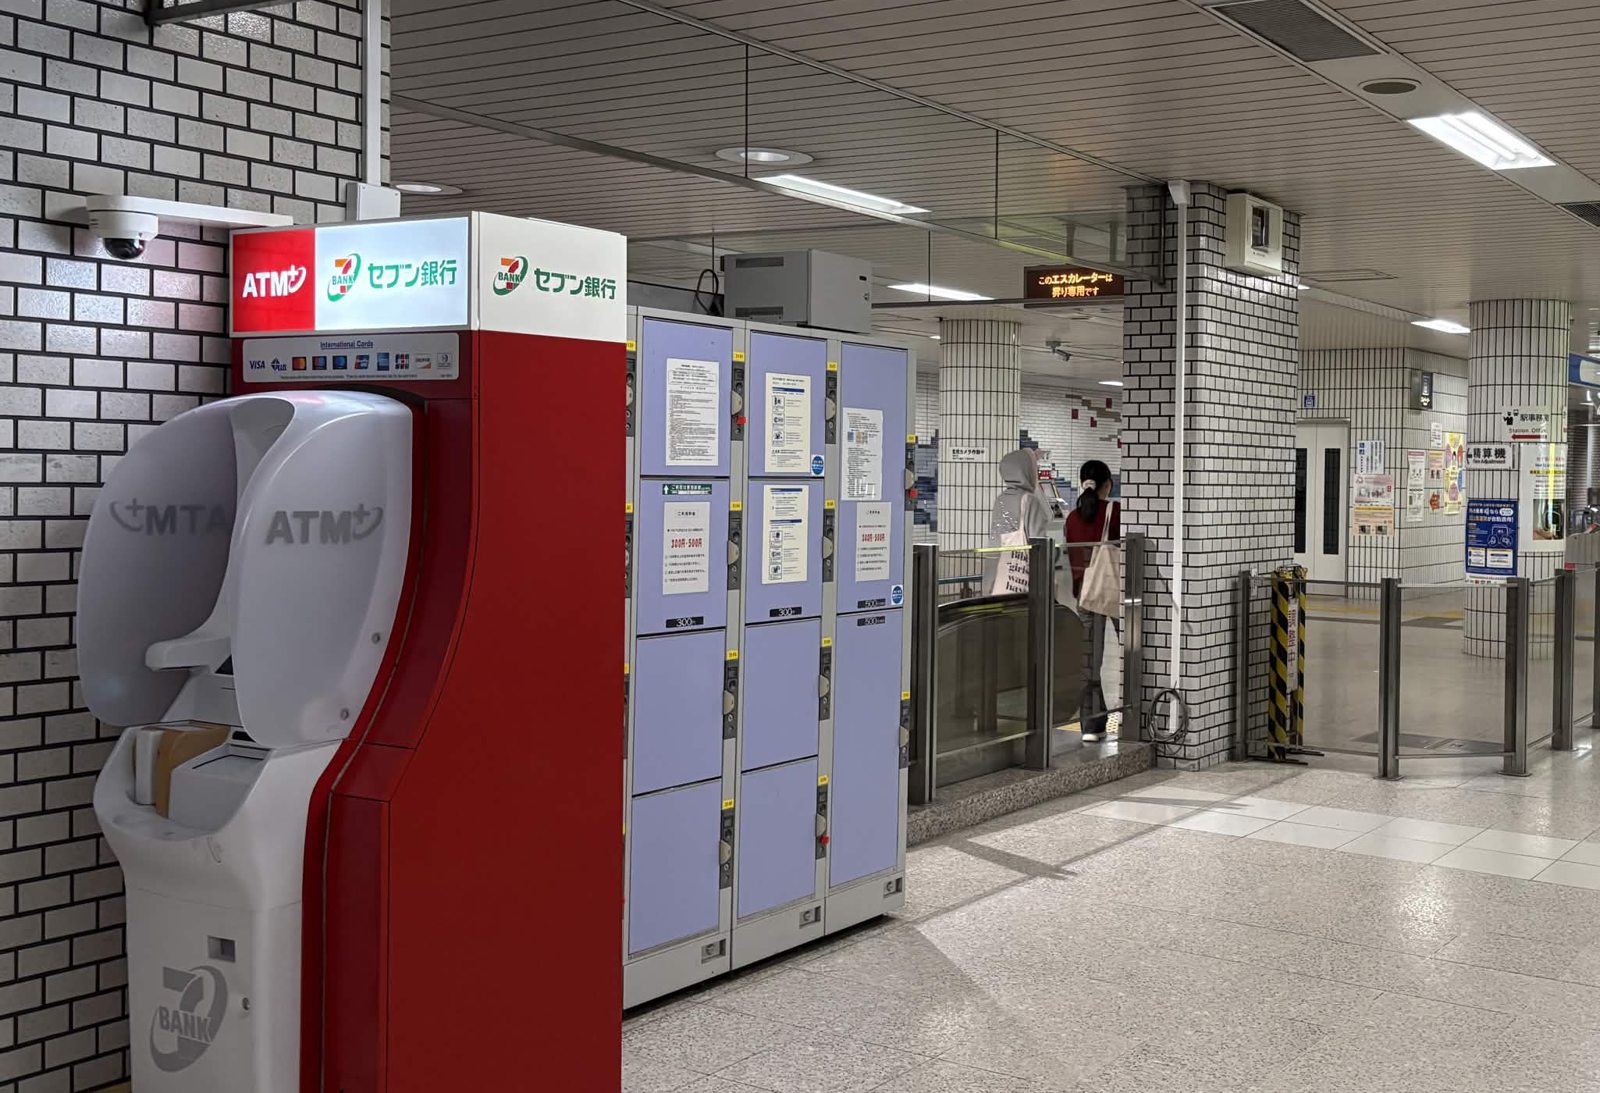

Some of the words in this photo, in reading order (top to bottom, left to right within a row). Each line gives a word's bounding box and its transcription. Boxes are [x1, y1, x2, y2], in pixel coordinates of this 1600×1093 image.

[332, 274, 355, 285] BANK
[368, 260, 457, 289] セブン銀行
[498, 271, 521, 282] BANK
[1038, 272, 1113, 285] このエスカレーターは
[534, 268, 616, 299] セブン銀行
[1052, 286, 1099, 298] 昇り専用です
[320, 341, 355, 349] International
[357, 340, 373, 348] Cards
[249, 360, 265, 369] VISA
[1473, 448, 1506, 459] 精算機
[159, 1006, 212, 1043] BANK
